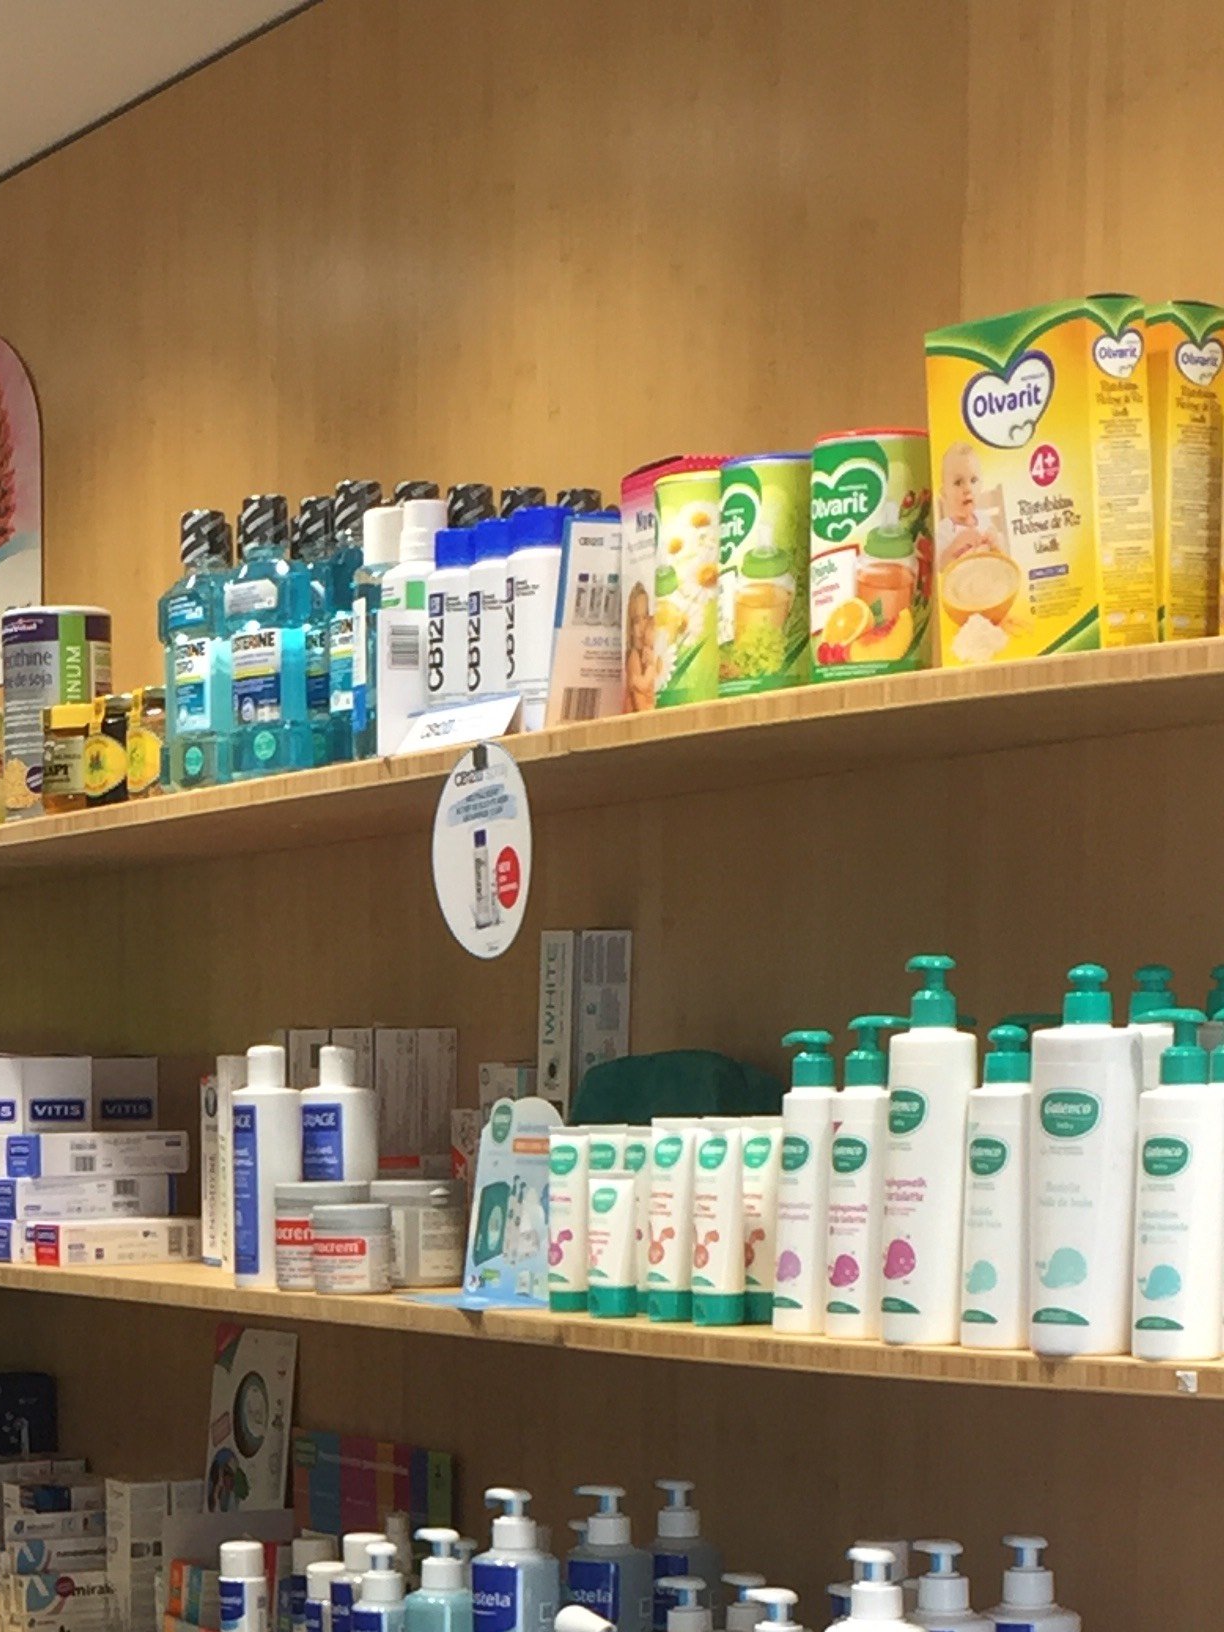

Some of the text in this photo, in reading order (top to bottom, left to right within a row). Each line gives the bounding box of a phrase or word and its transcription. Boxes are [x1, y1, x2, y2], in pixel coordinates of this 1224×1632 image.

[973, 382, 1042, 418] Olvarit
[428, 618, 445, 692] CB12
[467, 617, 481, 692] CB12
[34, 1104, 81, 1117] VITIS
[105, 1103, 149, 1115] VITIS
[473, 1590, 512, 1608] stela
[575, 1588, 613, 1604] stela
